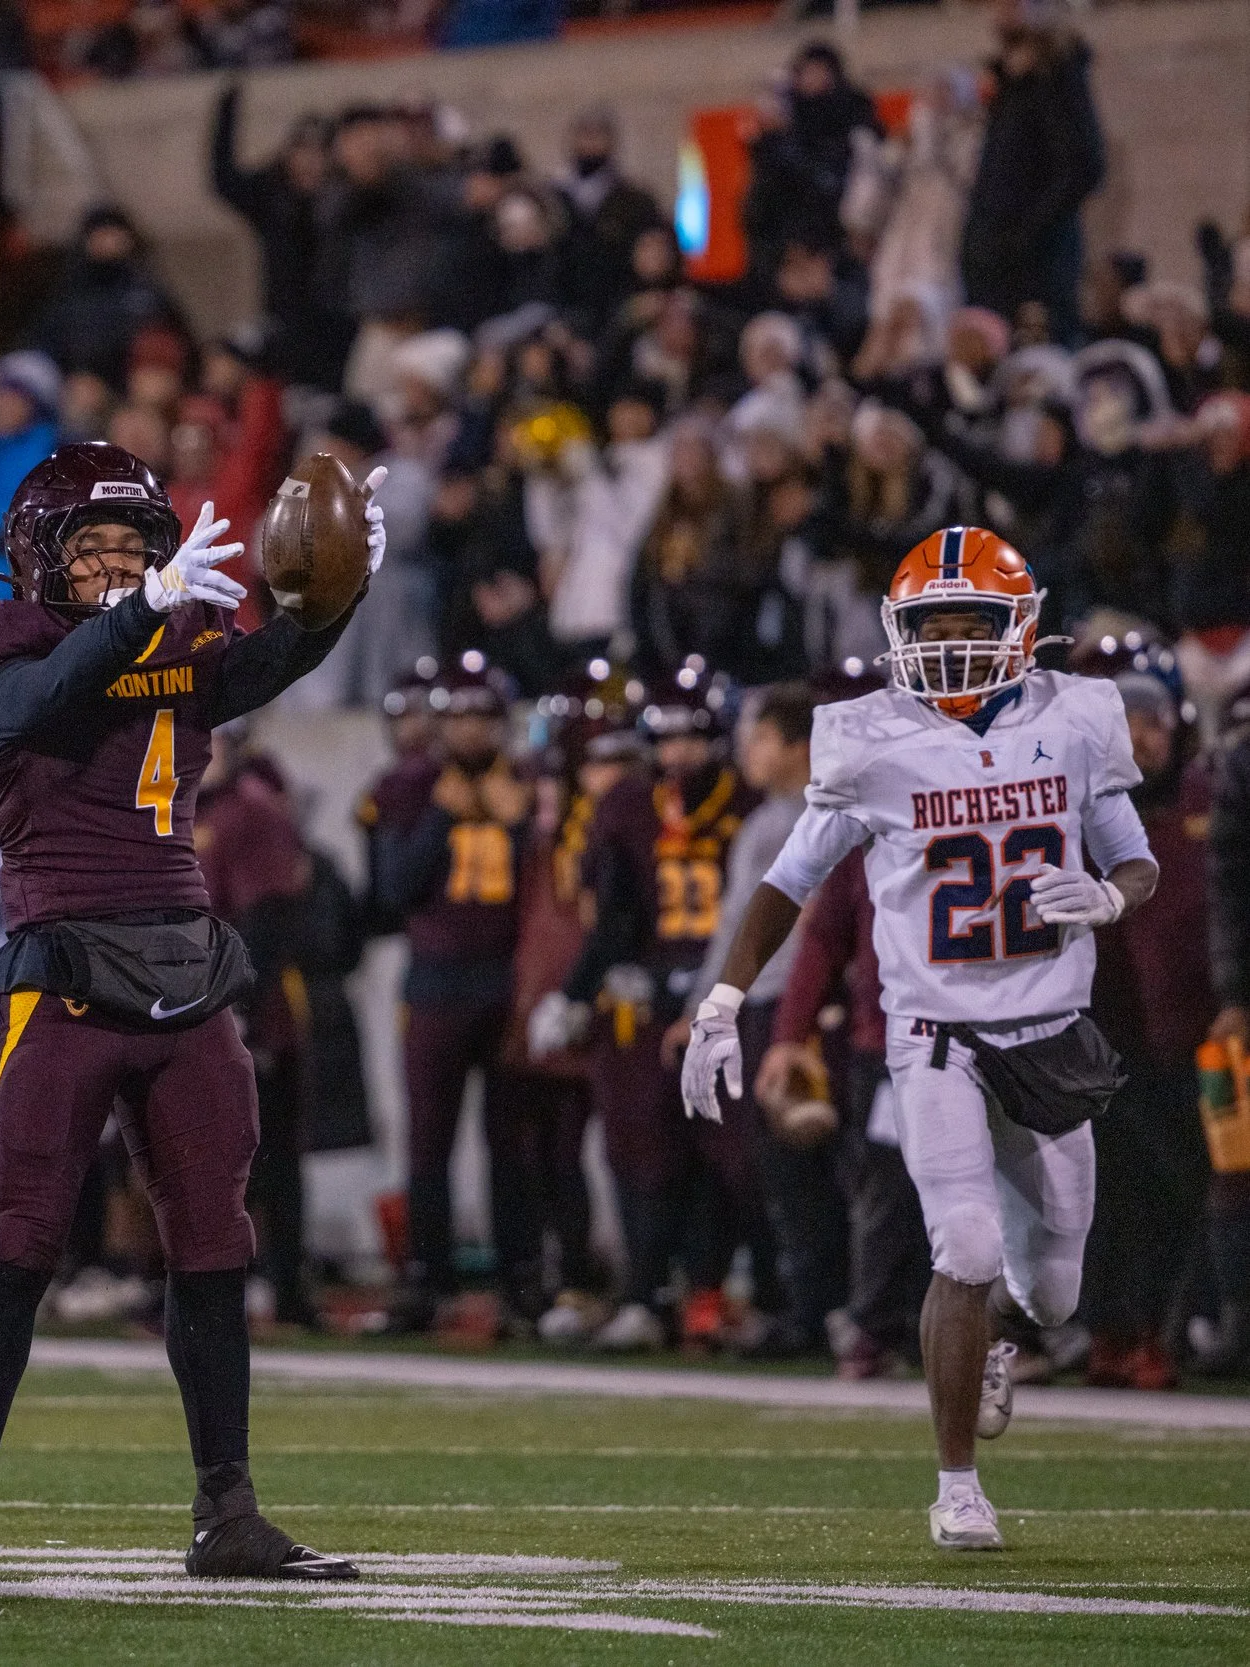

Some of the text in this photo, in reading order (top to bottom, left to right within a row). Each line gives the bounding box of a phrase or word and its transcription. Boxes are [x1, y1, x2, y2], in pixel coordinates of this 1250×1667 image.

[101, 485, 142, 497] MONTINI
[928, 580, 968, 590] Riddell
[190, 630, 224, 652] adidas
[135, 708, 180, 837] 4
[911, 774, 1068, 830] ROCHESTER
[924, 821, 1066, 965] 22
